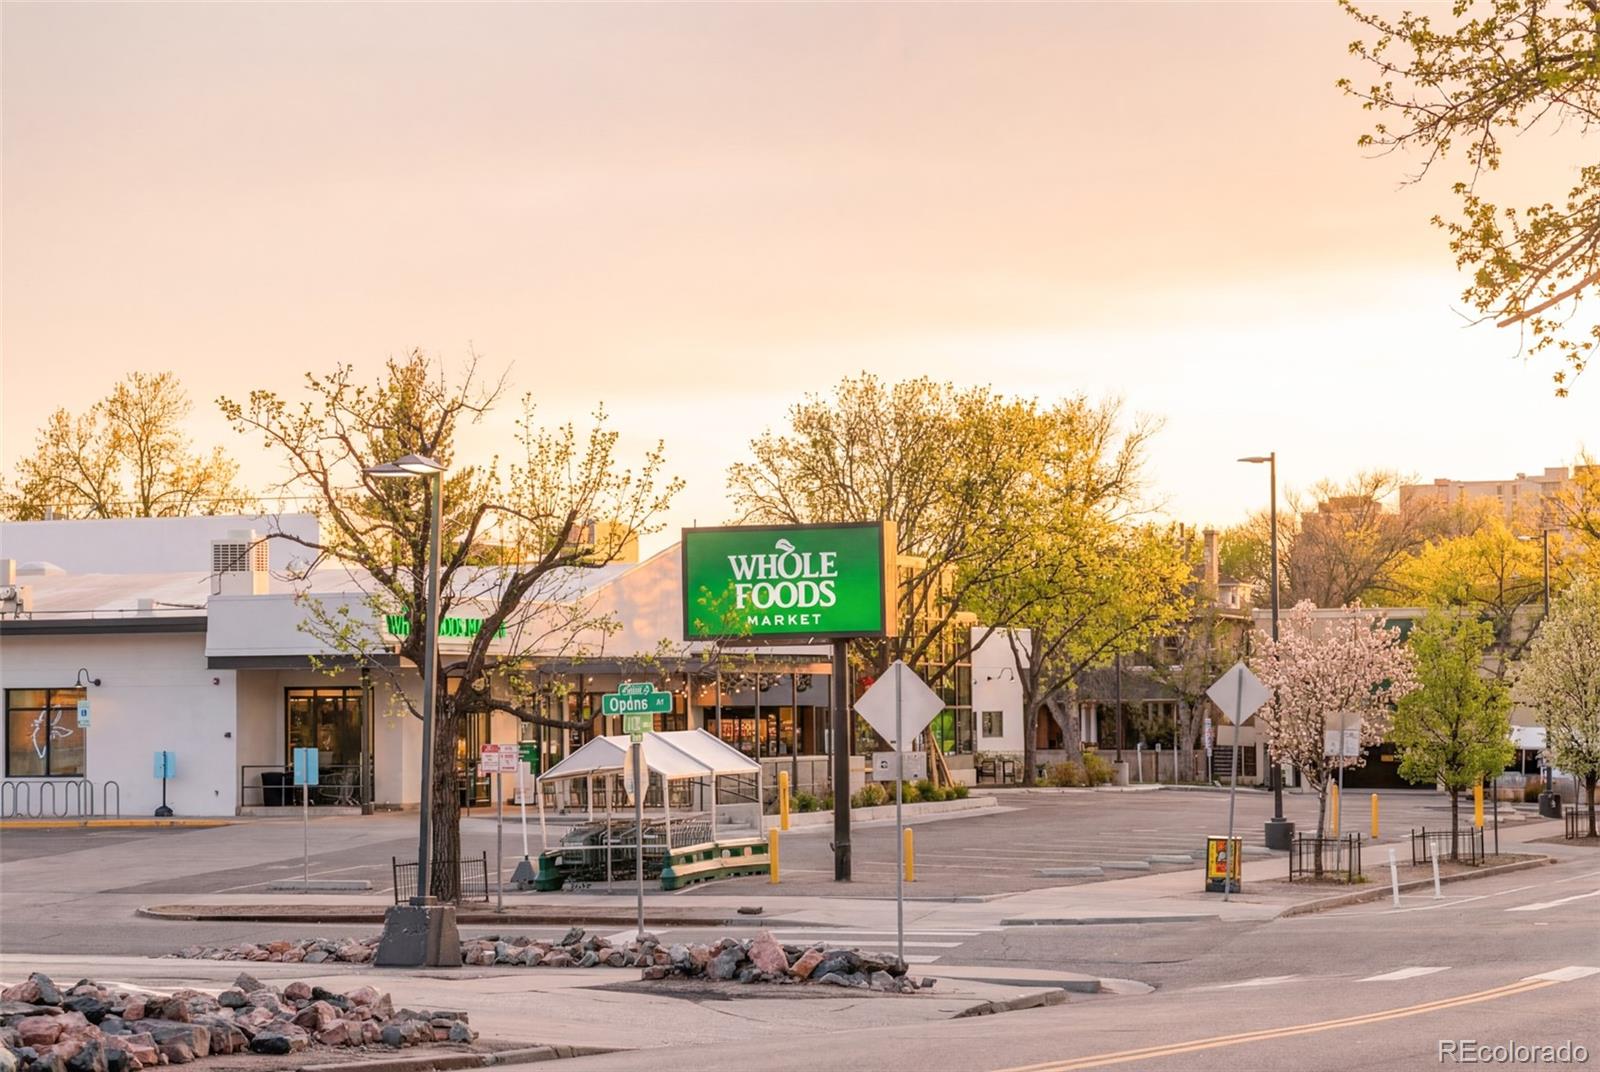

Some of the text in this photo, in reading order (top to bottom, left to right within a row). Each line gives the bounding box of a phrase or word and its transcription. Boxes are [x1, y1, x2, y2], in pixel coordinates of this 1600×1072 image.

[728, 551, 838, 580] WHOLE
[735, 580, 836, 609] FOODS
[748, 613, 821, 626] MARKET
